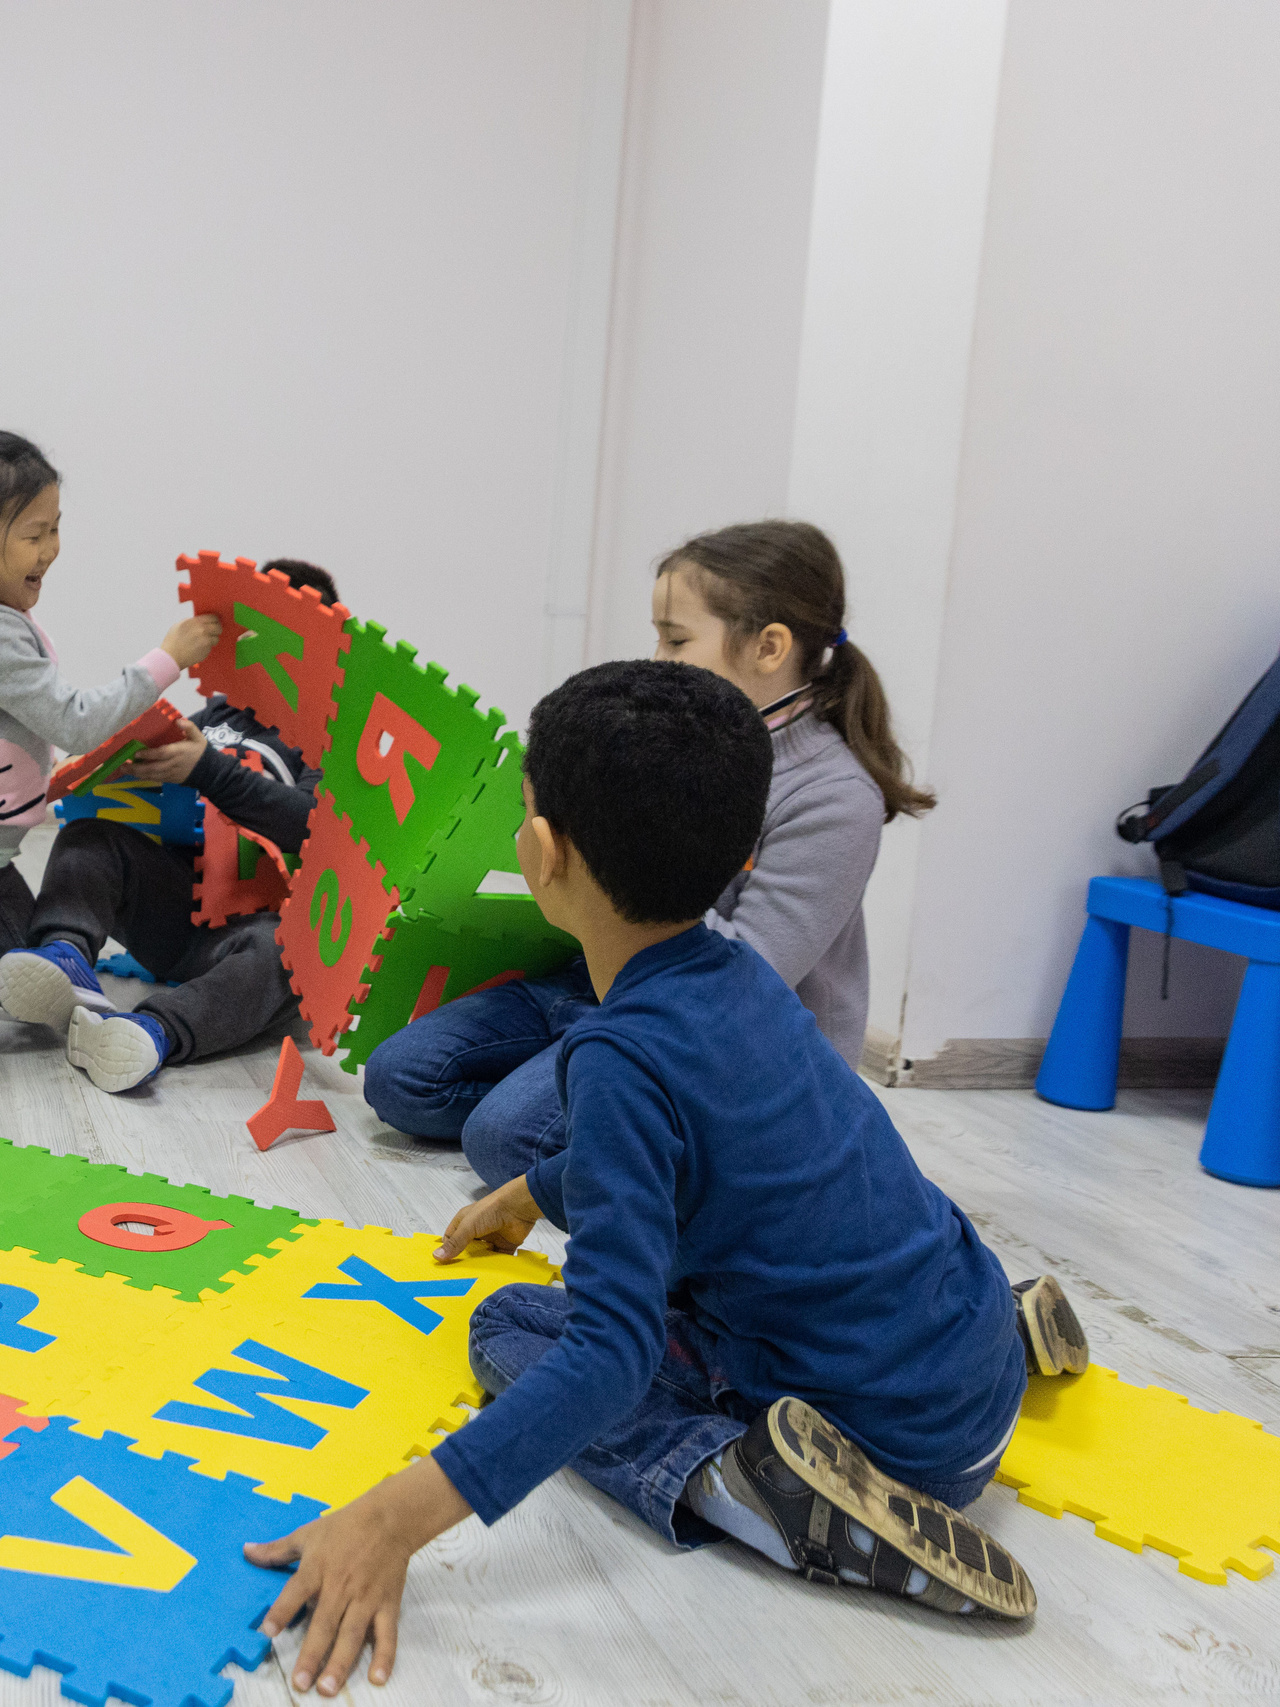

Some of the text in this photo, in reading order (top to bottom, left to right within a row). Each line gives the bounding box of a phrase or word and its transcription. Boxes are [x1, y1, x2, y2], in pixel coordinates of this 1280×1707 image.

[234, 601, 304, 714] K
[78, 1202, 235, 1252] Q
[300, 1254, 479, 1337] X
